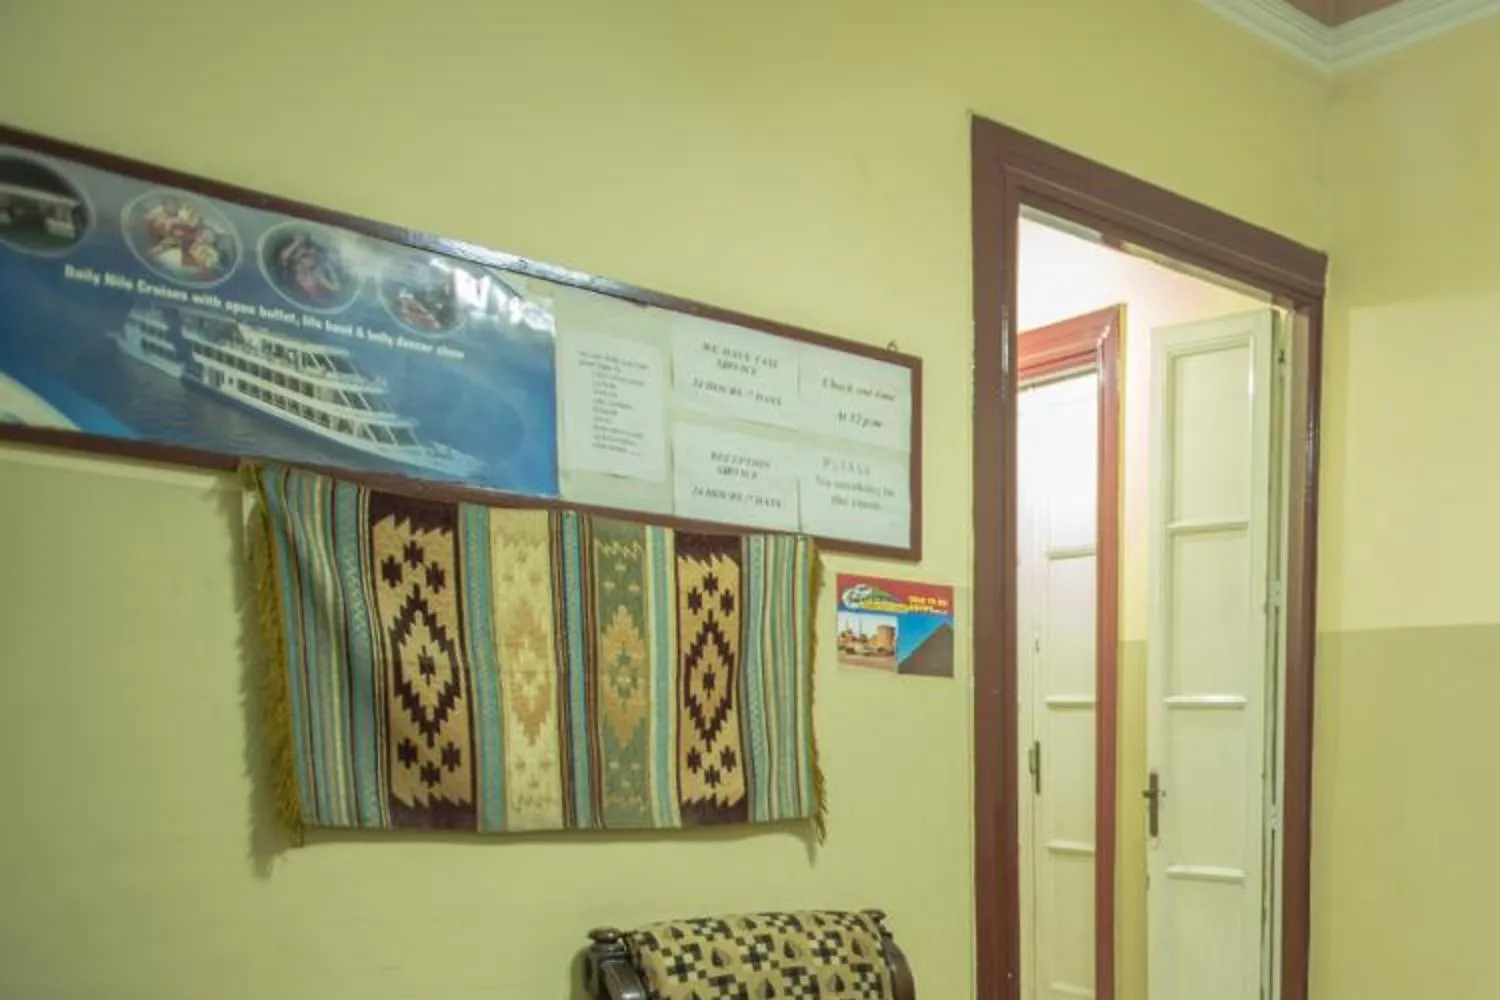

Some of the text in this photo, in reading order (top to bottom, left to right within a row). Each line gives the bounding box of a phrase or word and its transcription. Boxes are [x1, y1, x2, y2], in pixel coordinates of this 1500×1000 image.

[64, 263, 100, 287] Daily
[136, 278, 188, 302] Cruises
[191, 292, 222, 308] with
[225, 300, 256, 316] open
[355, 325, 366, 339] &
[822, 377, 853, 394] Check
[711, 451, 771, 470] RECEPTION
[834, 481, 881, 498] smoking
